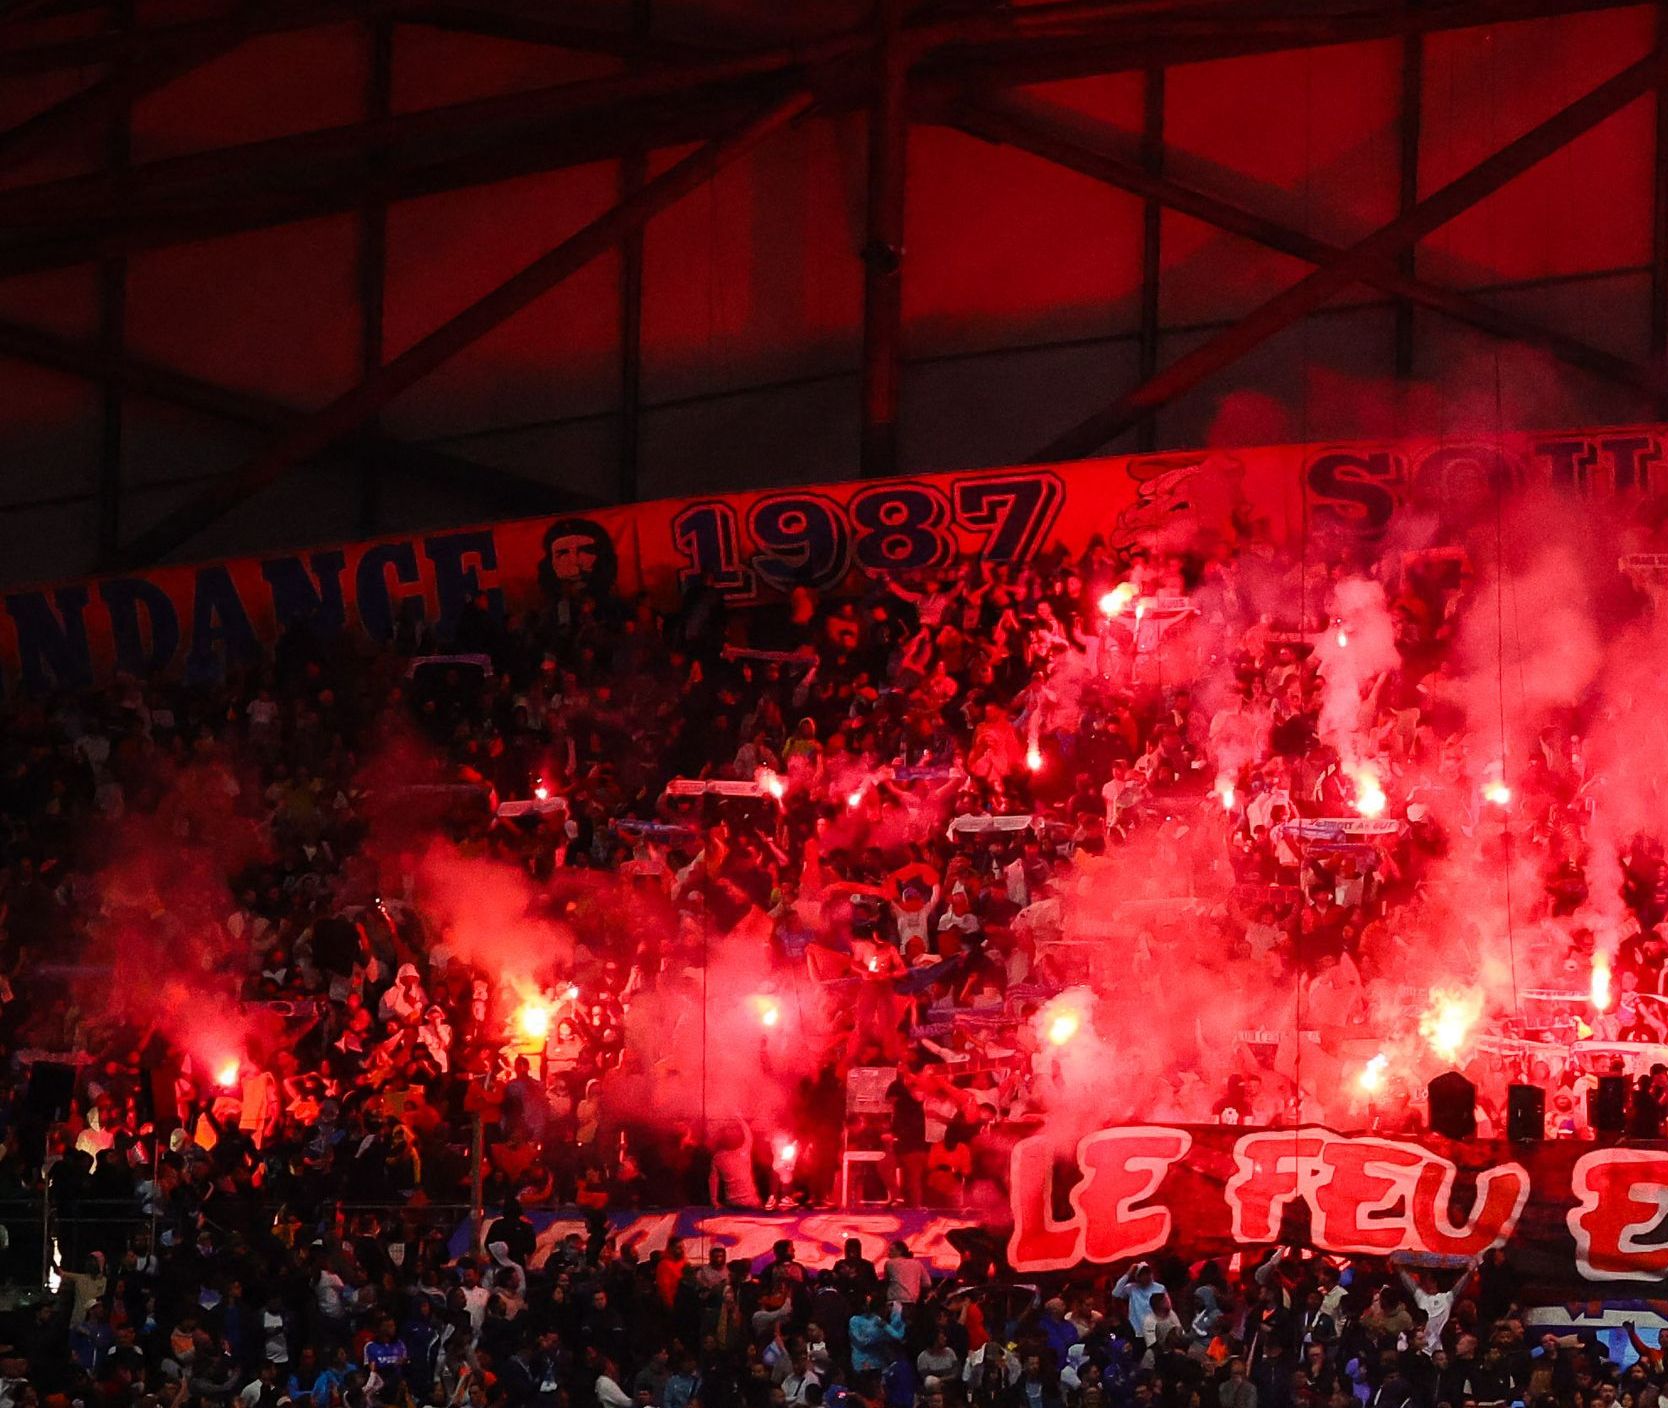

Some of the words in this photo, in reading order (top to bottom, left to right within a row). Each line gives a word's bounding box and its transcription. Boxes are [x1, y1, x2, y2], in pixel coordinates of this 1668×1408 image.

[672, 470, 1068, 600] 1987
[1007, 1127, 1191, 1273] LE
[1229, 1126, 1530, 1258] FEU
